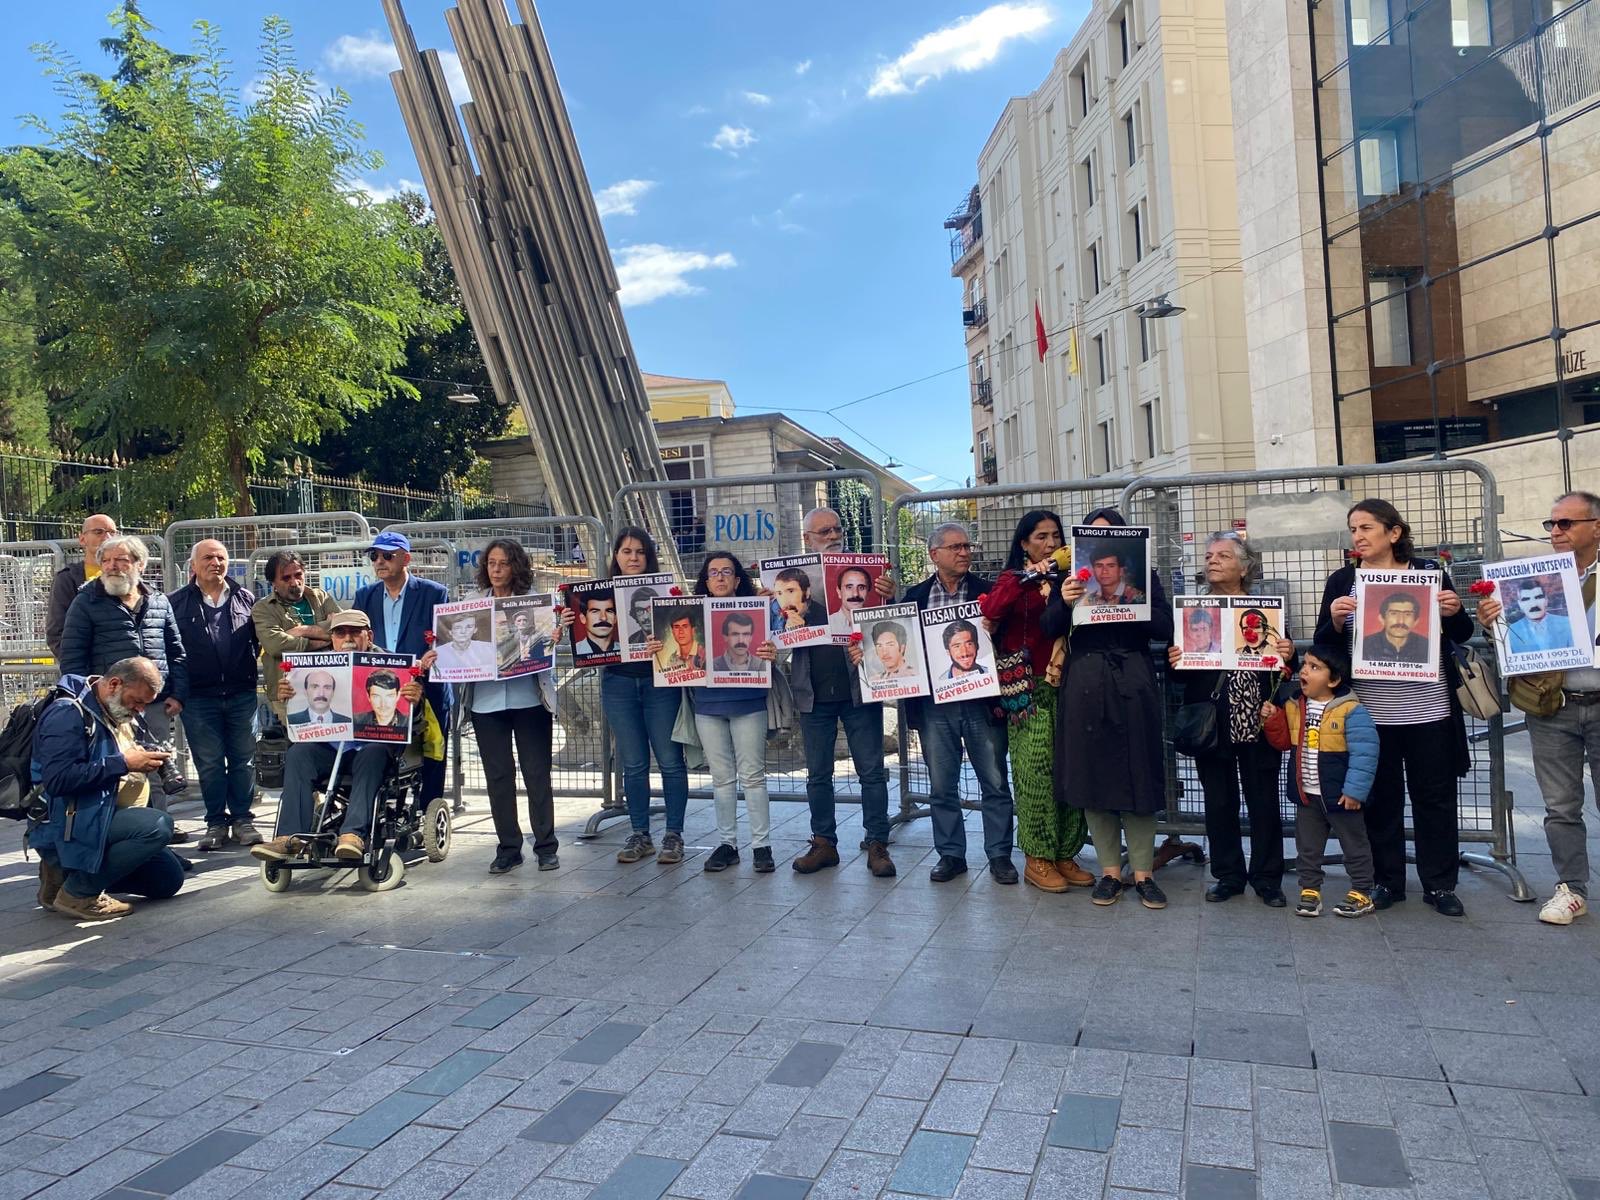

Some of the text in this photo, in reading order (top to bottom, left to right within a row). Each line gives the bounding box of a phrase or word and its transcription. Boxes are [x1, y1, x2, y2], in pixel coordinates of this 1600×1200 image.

[715, 509, 775, 541] POLİS
[824, 556, 884, 564] KENAN BİLGİN
[1531, 558, 1573, 574] YURTSEVEN
[655, 575, 673, 583] EREN
[1361, 574, 1438, 584] YUSUF ERİŞTİ
[573, 583, 593, 593] AGİT
[436, 600, 493, 614] AYHAN EFEOĞLU
[502, 599, 543, 608] Salih Akdeniz
[654, 598, 677, 606] TURGUT
[1201, 599, 1220, 608] ÇELİK
[1262, 599, 1279, 608] ÇELİK
[854, 606, 916, 621] MURAT YILDIZ
[924, 605, 982, 624] HASAN OCAK
[315, 654, 348, 667] KARAKOÇ
[372, 657, 385, 666] Şah
[387, 658, 406, 666] Atala
